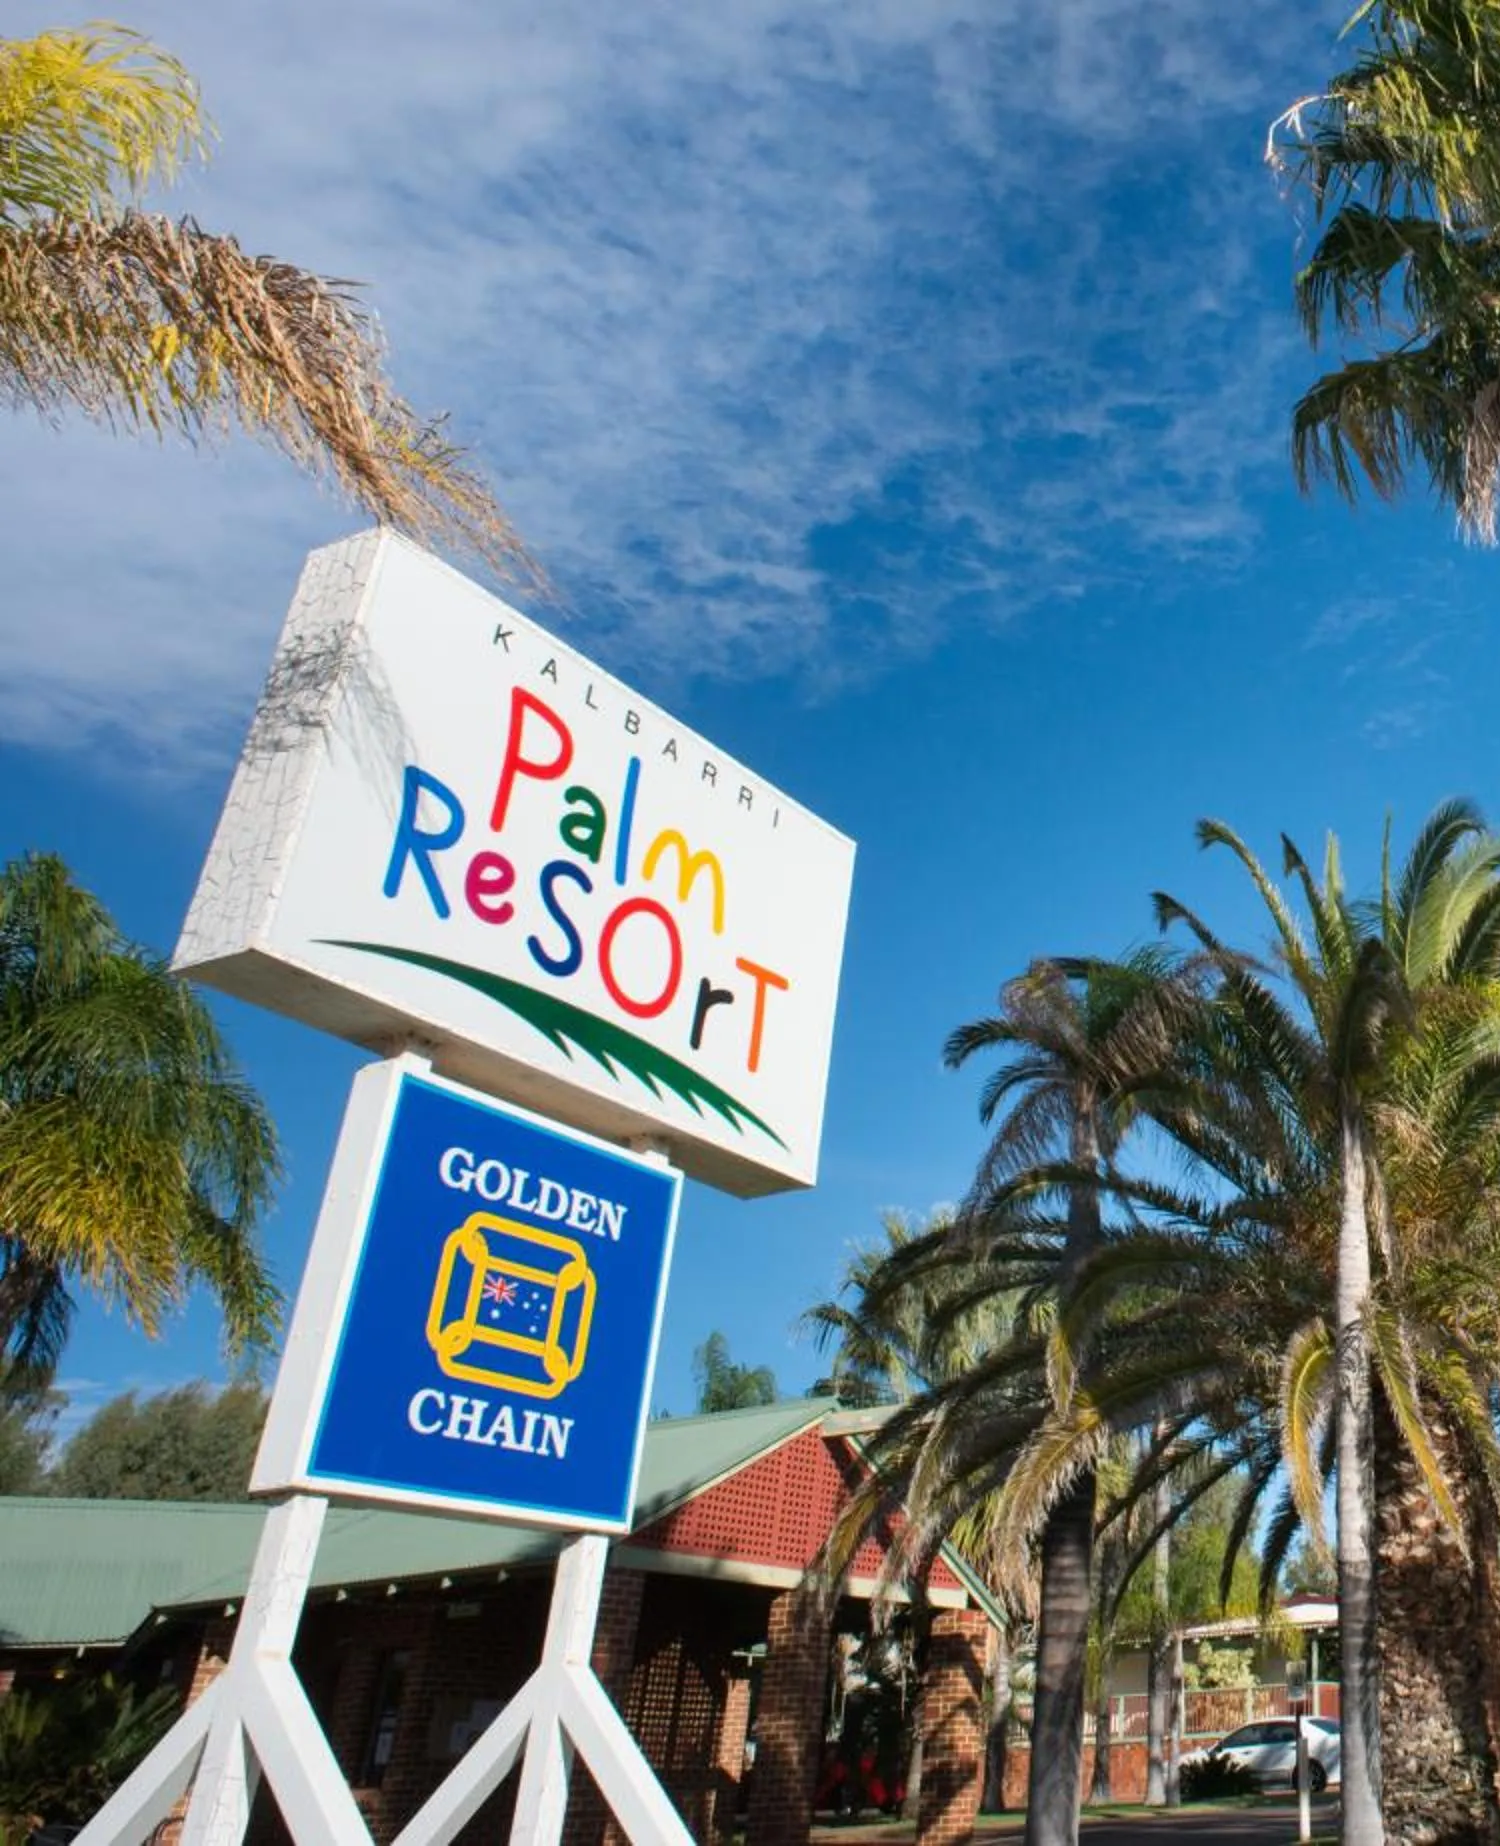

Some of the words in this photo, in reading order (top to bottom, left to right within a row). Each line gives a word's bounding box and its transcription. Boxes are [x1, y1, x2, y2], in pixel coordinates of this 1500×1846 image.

[493, 624, 780, 828] KALBARRI
[490, 686, 725, 935] Palm
[440, 1147, 627, 1241] GOLDEN
[408, 1389, 574, 1459] CHAIN
